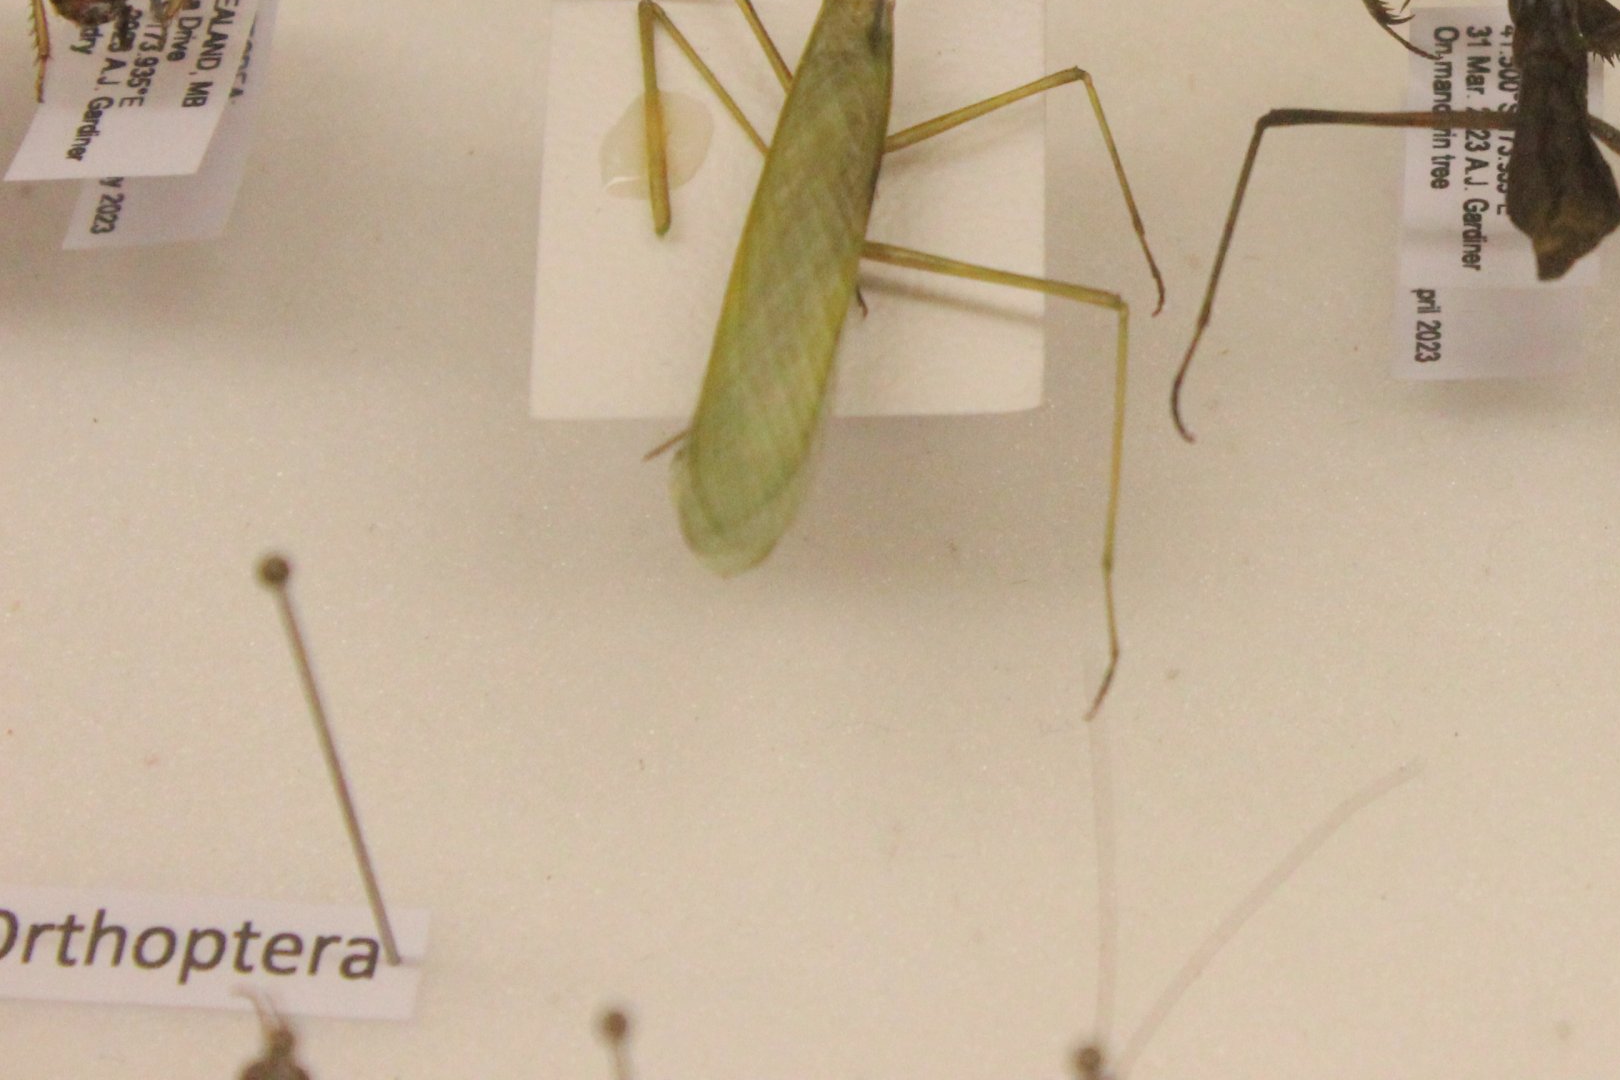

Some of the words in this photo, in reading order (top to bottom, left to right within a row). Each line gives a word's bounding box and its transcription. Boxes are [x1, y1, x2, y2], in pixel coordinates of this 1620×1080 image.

[166, 16, 204, 62] Drive
[1433, 26, 1460, 57] On
[1466, 26, 1492, 47] 31
[181, 81, 213, 108] MB
[66, 96, 114, 161] Gardiner
[1430, 154, 1456, 190] tree
[90, 192, 125, 235] 2023
[1461, 198, 1489, 270] Gardiner
[1411, 288, 1441, 314] pril
[1414, 320, 1442, 363] 2023
